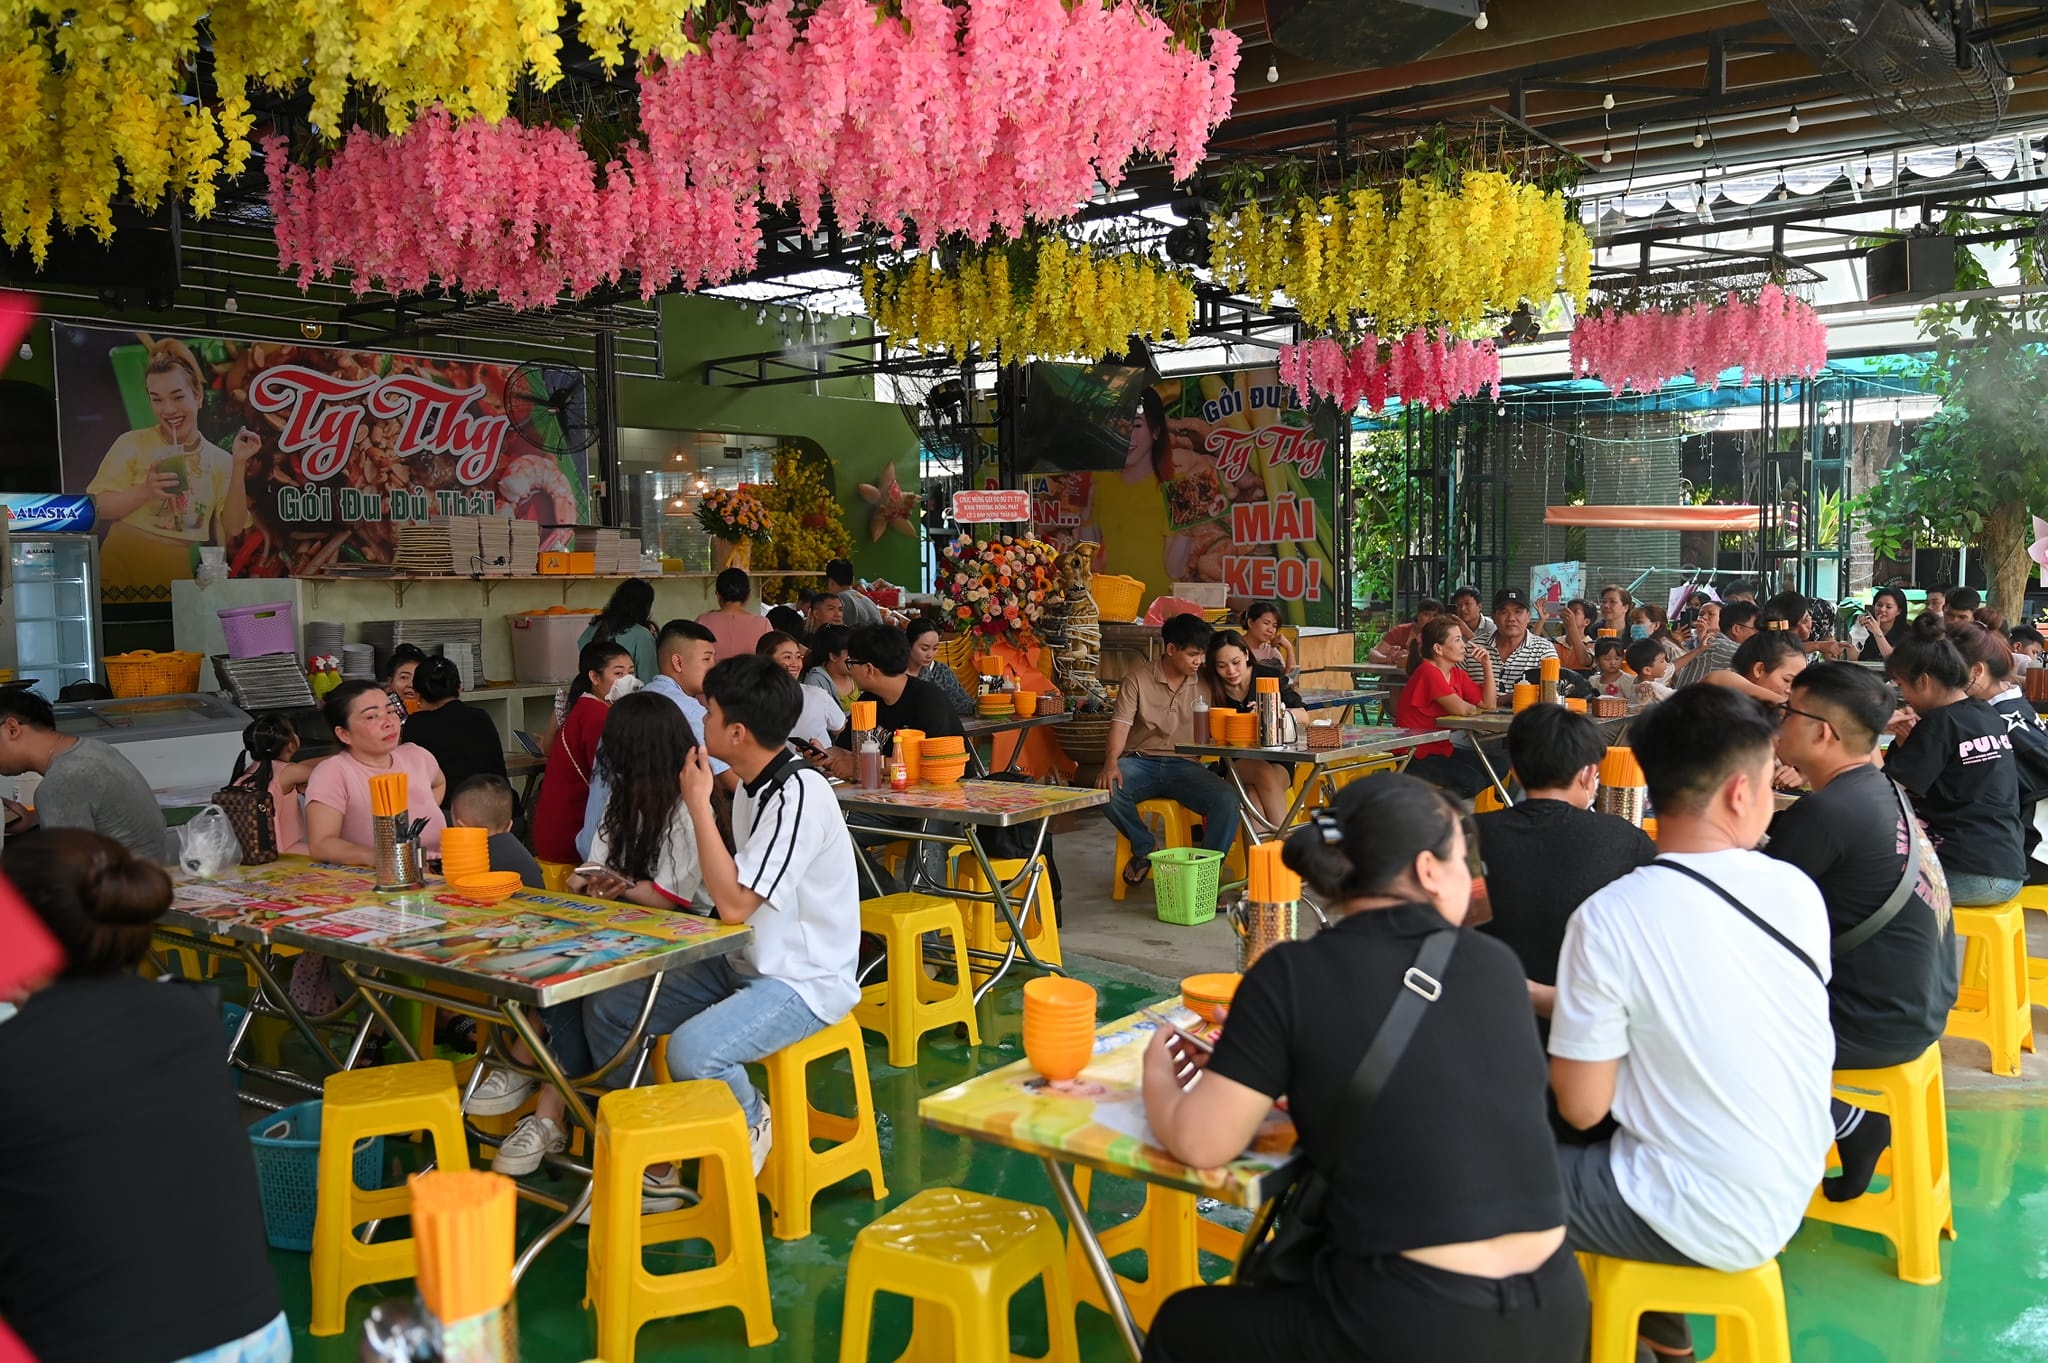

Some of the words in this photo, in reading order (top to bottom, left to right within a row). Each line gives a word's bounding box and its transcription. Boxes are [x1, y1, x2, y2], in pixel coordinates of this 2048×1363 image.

[249, 364, 381, 481] Ty
[368, 374, 510, 486] Thy
[1203, 387, 1242, 424] GỎI
[1249, 385, 1282, 409] ĐU
[1205, 427, 1261, 482] Ty
[1256, 424, 1329, 478] Thy
[17, 506, 79, 520] ALASKA
[278, 482, 332, 521] Gỏi
[340, 487, 381, 521] Đu
[390, 485, 429, 521] Đủ
[435, 489, 496, 516] Thái
[1231, 491, 1316, 545] MÃI
[1223, 556, 1321, 601] KEO!
